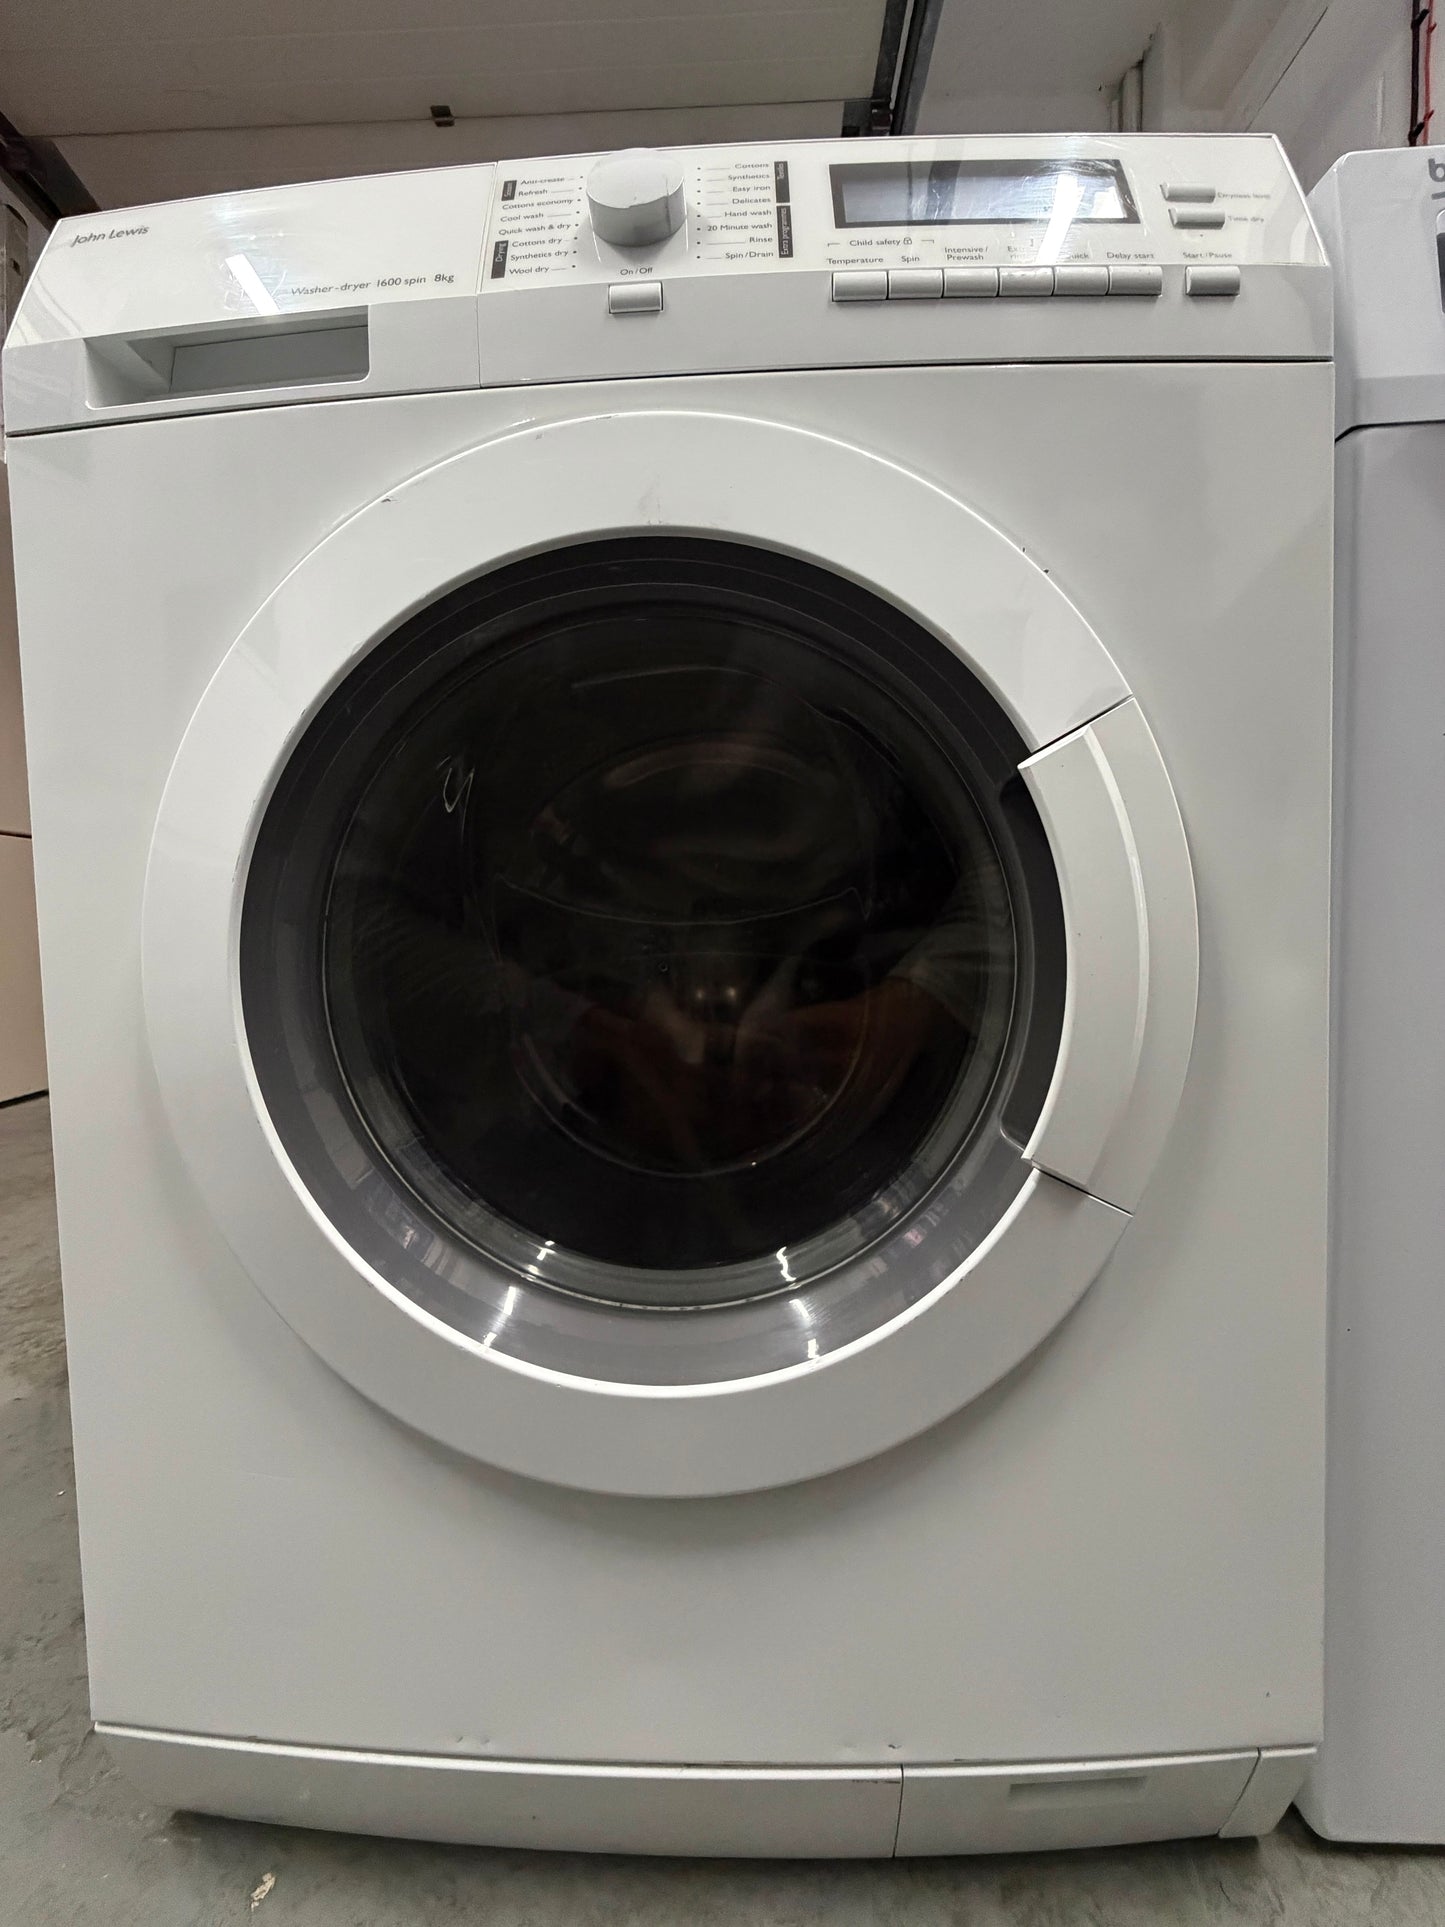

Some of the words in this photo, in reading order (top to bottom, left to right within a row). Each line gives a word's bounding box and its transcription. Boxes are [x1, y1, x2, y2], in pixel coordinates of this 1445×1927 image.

[732, 185, 751, 193] Easy
[732, 197, 771, 205] Delicates
[502, 202, 534, 210] Cottons
[724, 210, 748, 218] Hand
[500, 215, 521, 223] Cool
[498, 228, 523, 236] Quick
[525, 225, 546, 233] wash
[557, 222, 571, 230] dry
[720, 223, 749, 231] Minute
[70, 232, 105, 247] John
[108, 225, 149, 239] Lewis
[510, 253, 552, 261] Synthetics
[554, 250, 569, 258] dry
[725, 250, 774, 260] Spin/Drain
[946, 254, 984, 262] Prewash
[1106, 252, 1131, 260] Delay
[827, 257, 884, 265] Temperature
[901, 255, 920, 264] Spin
[509, 267, 533, 275] Wool
[535, 265, 550, 273] dry
[620, 267, 653, 276] On/Off
[291, 281, 371, 296] Washer-dryer
[377, 277, 402, 288] 1600
[404, 277, 427, 286] spin
[434, 273, 455, 284] 8kg
